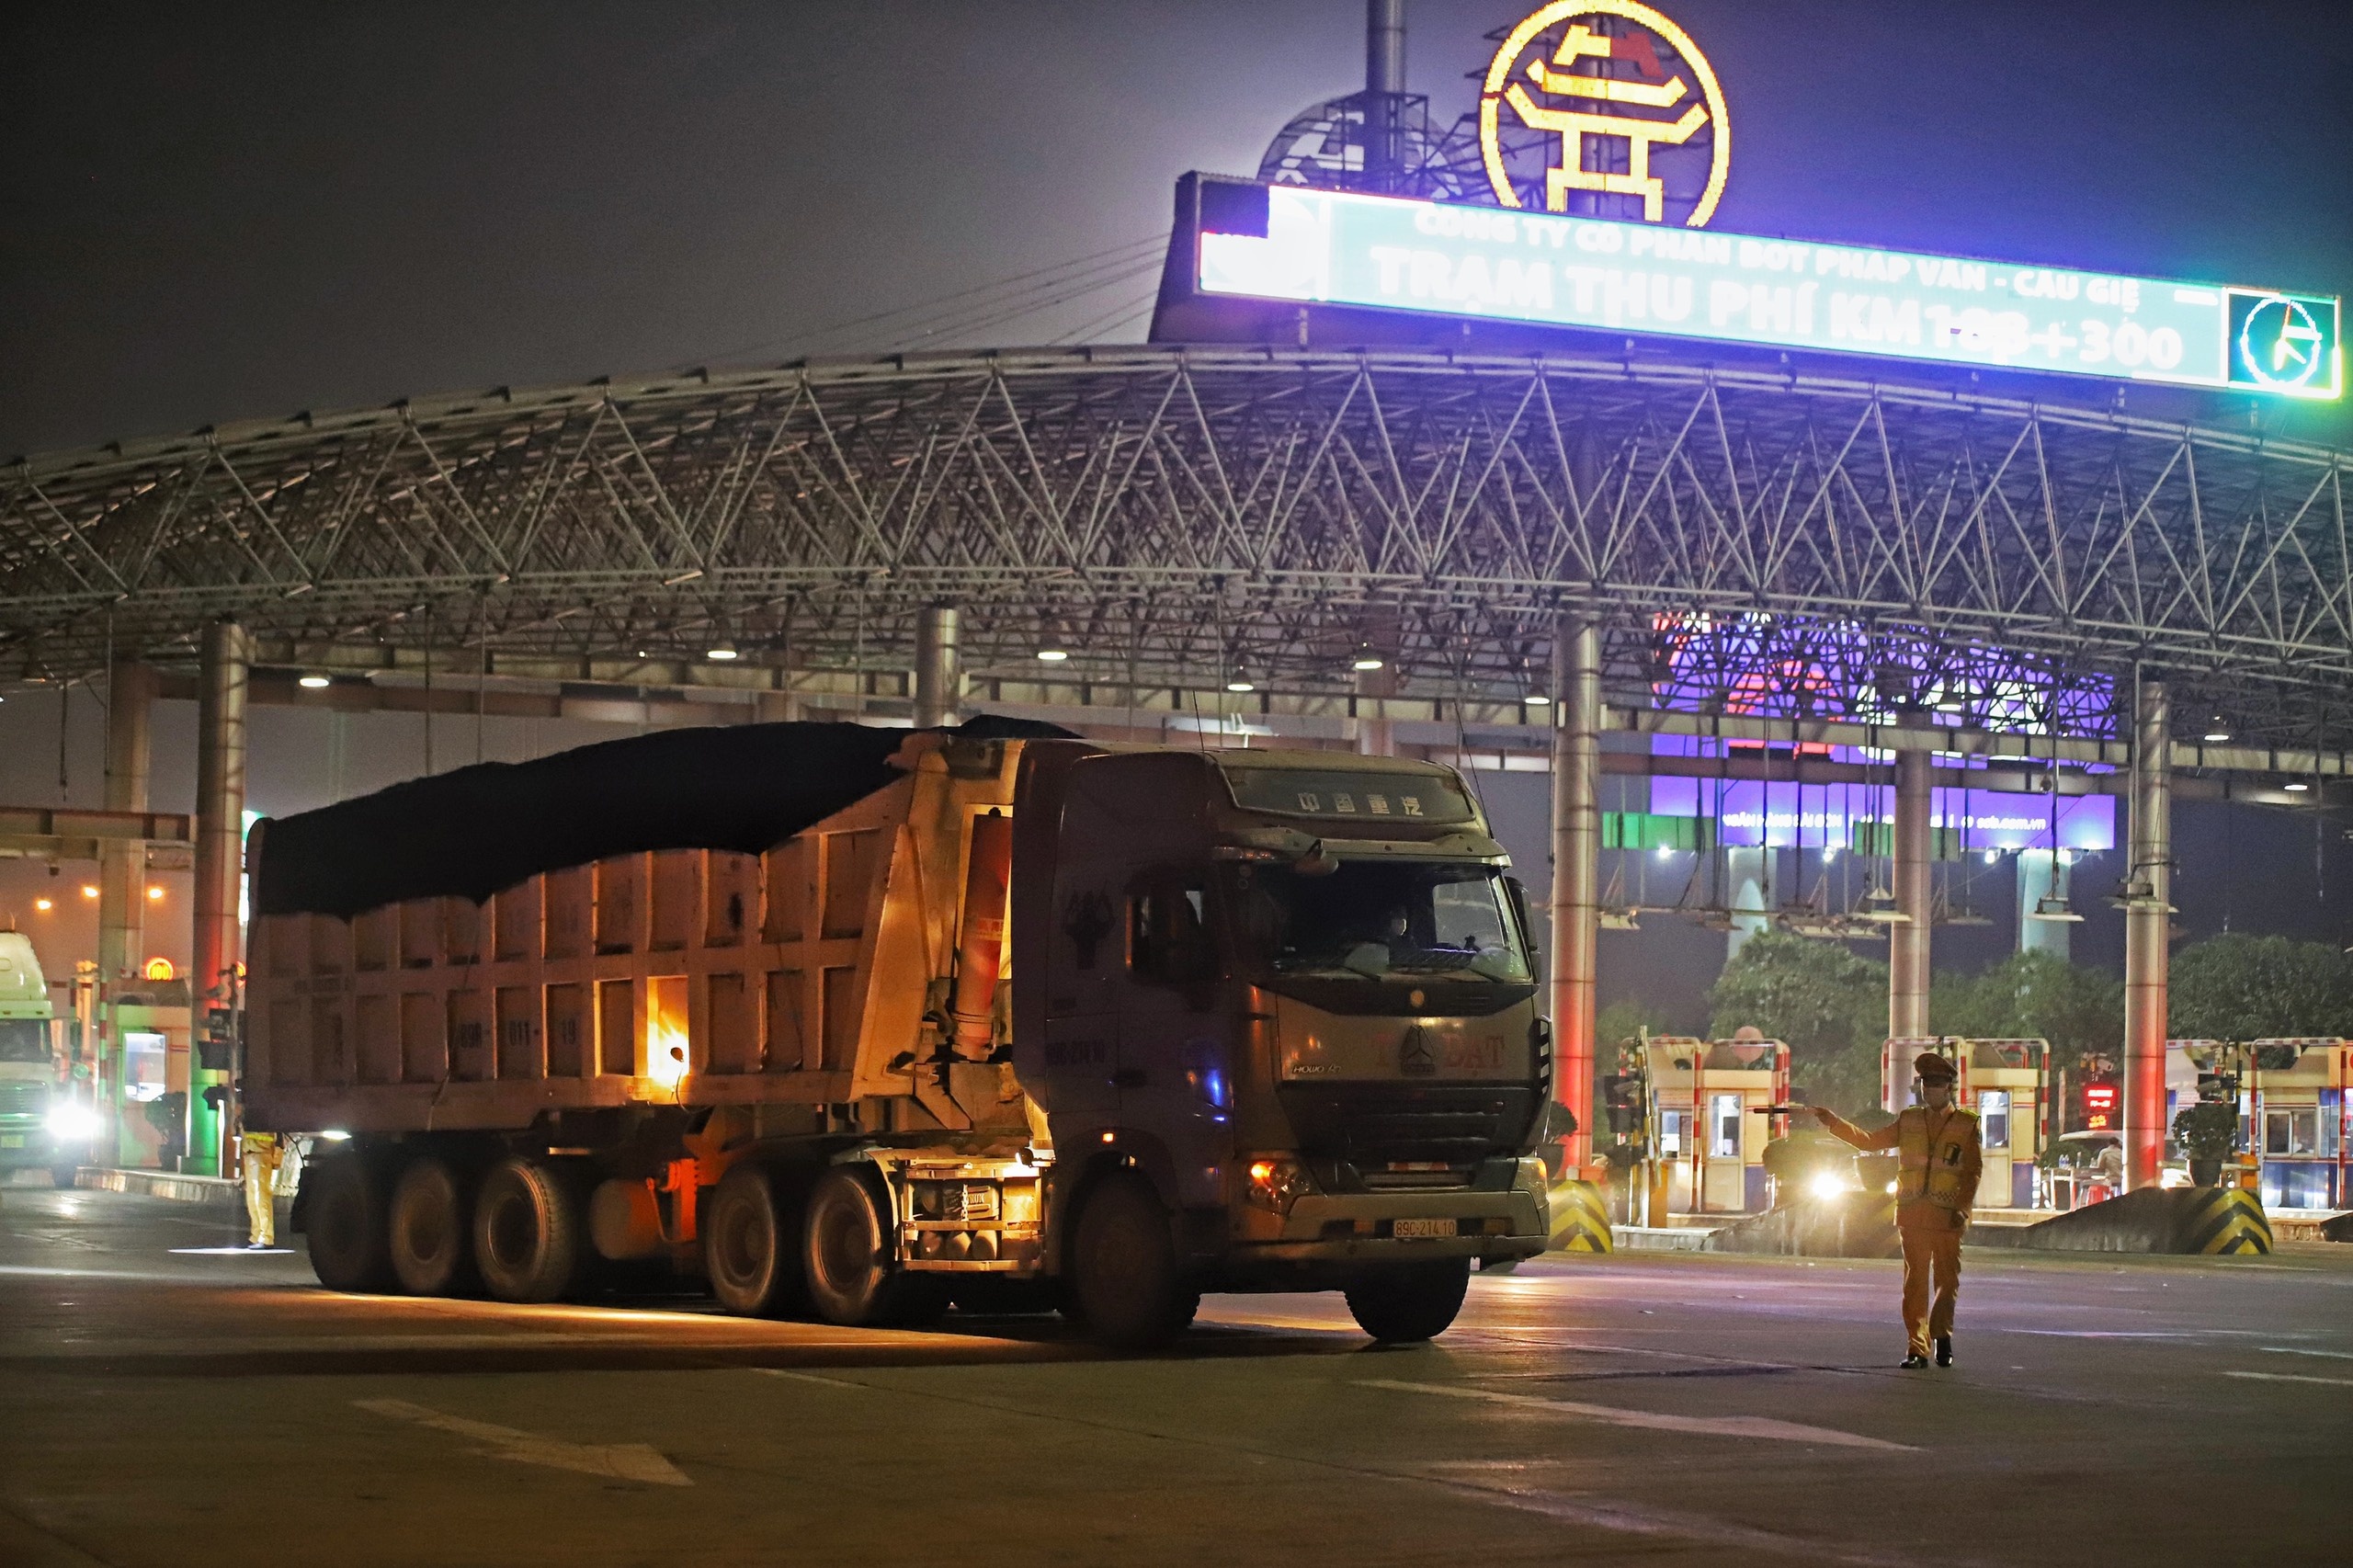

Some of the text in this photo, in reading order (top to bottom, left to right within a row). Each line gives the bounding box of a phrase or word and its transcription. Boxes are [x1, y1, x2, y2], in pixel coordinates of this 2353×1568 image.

[1522, 217, 1571, 248] TY
[1739, 240, 1810, 271] BOT
[1370, 245, 1552, 312] TRẠM
[1565, 266, 1692, 322] THU
[1710, 279, 1819, 335] PHÍ
[1292, 1064, 1324, 1074] HOWO
